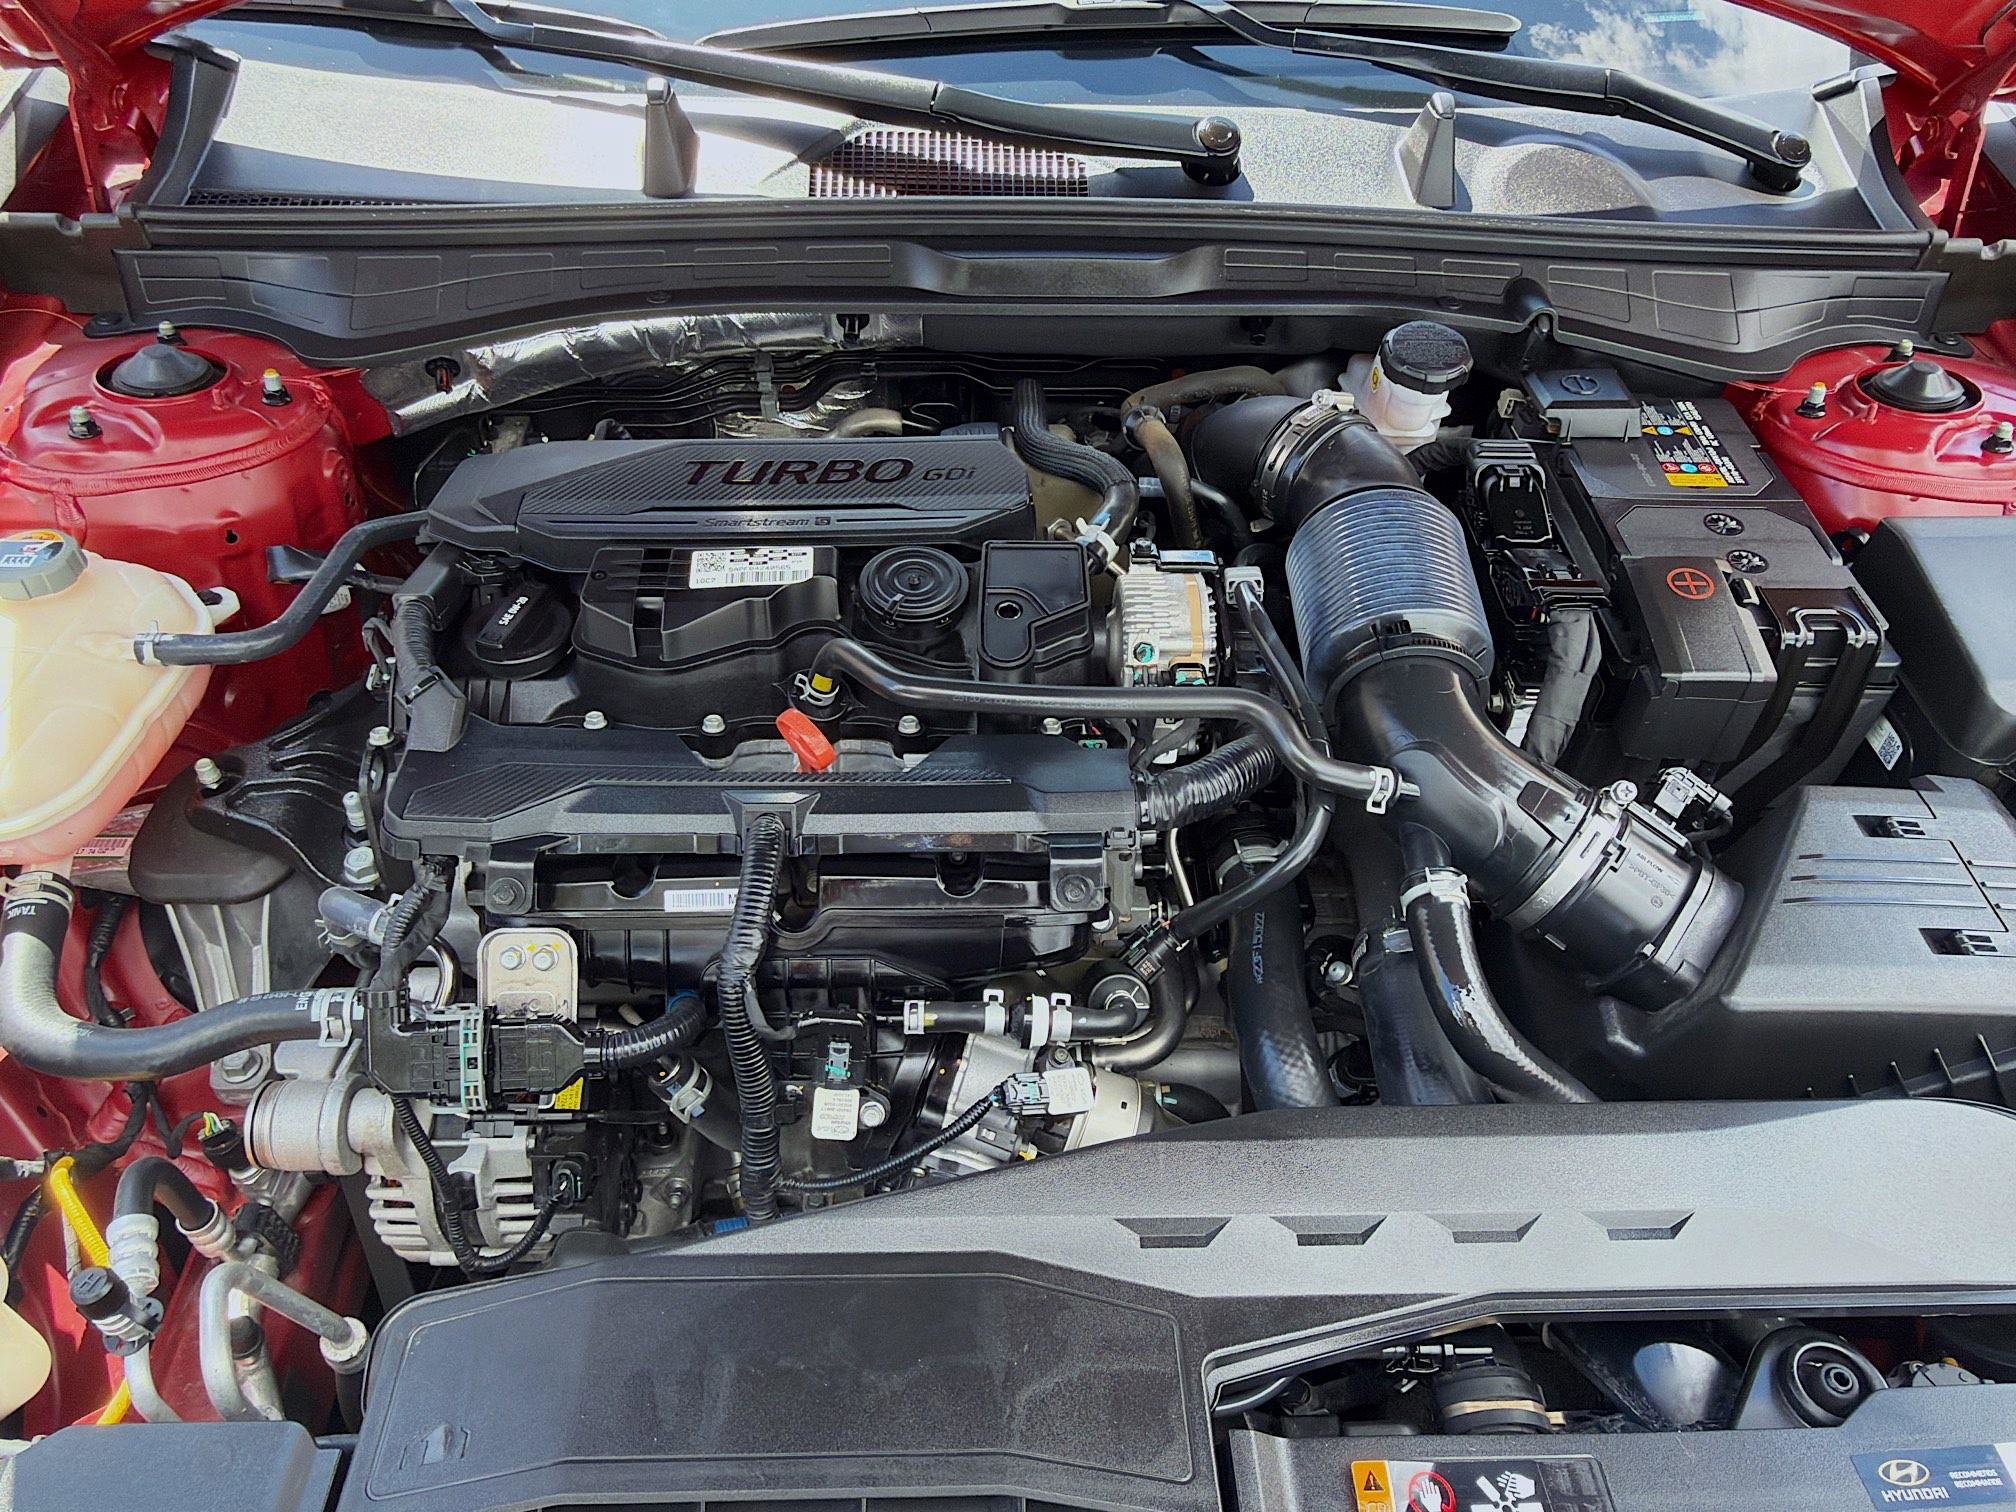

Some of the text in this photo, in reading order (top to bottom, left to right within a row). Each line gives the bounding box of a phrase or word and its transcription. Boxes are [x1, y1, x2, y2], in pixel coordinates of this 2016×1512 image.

[686, 458, 914, 485] TURBO
[704, 517, 810, 528] Smartstream
[498, 613, 515, 626] SAE
[7, 905, 37, 920] TANK
[1881, 1487, 1950, 1502] HYUNDAI
